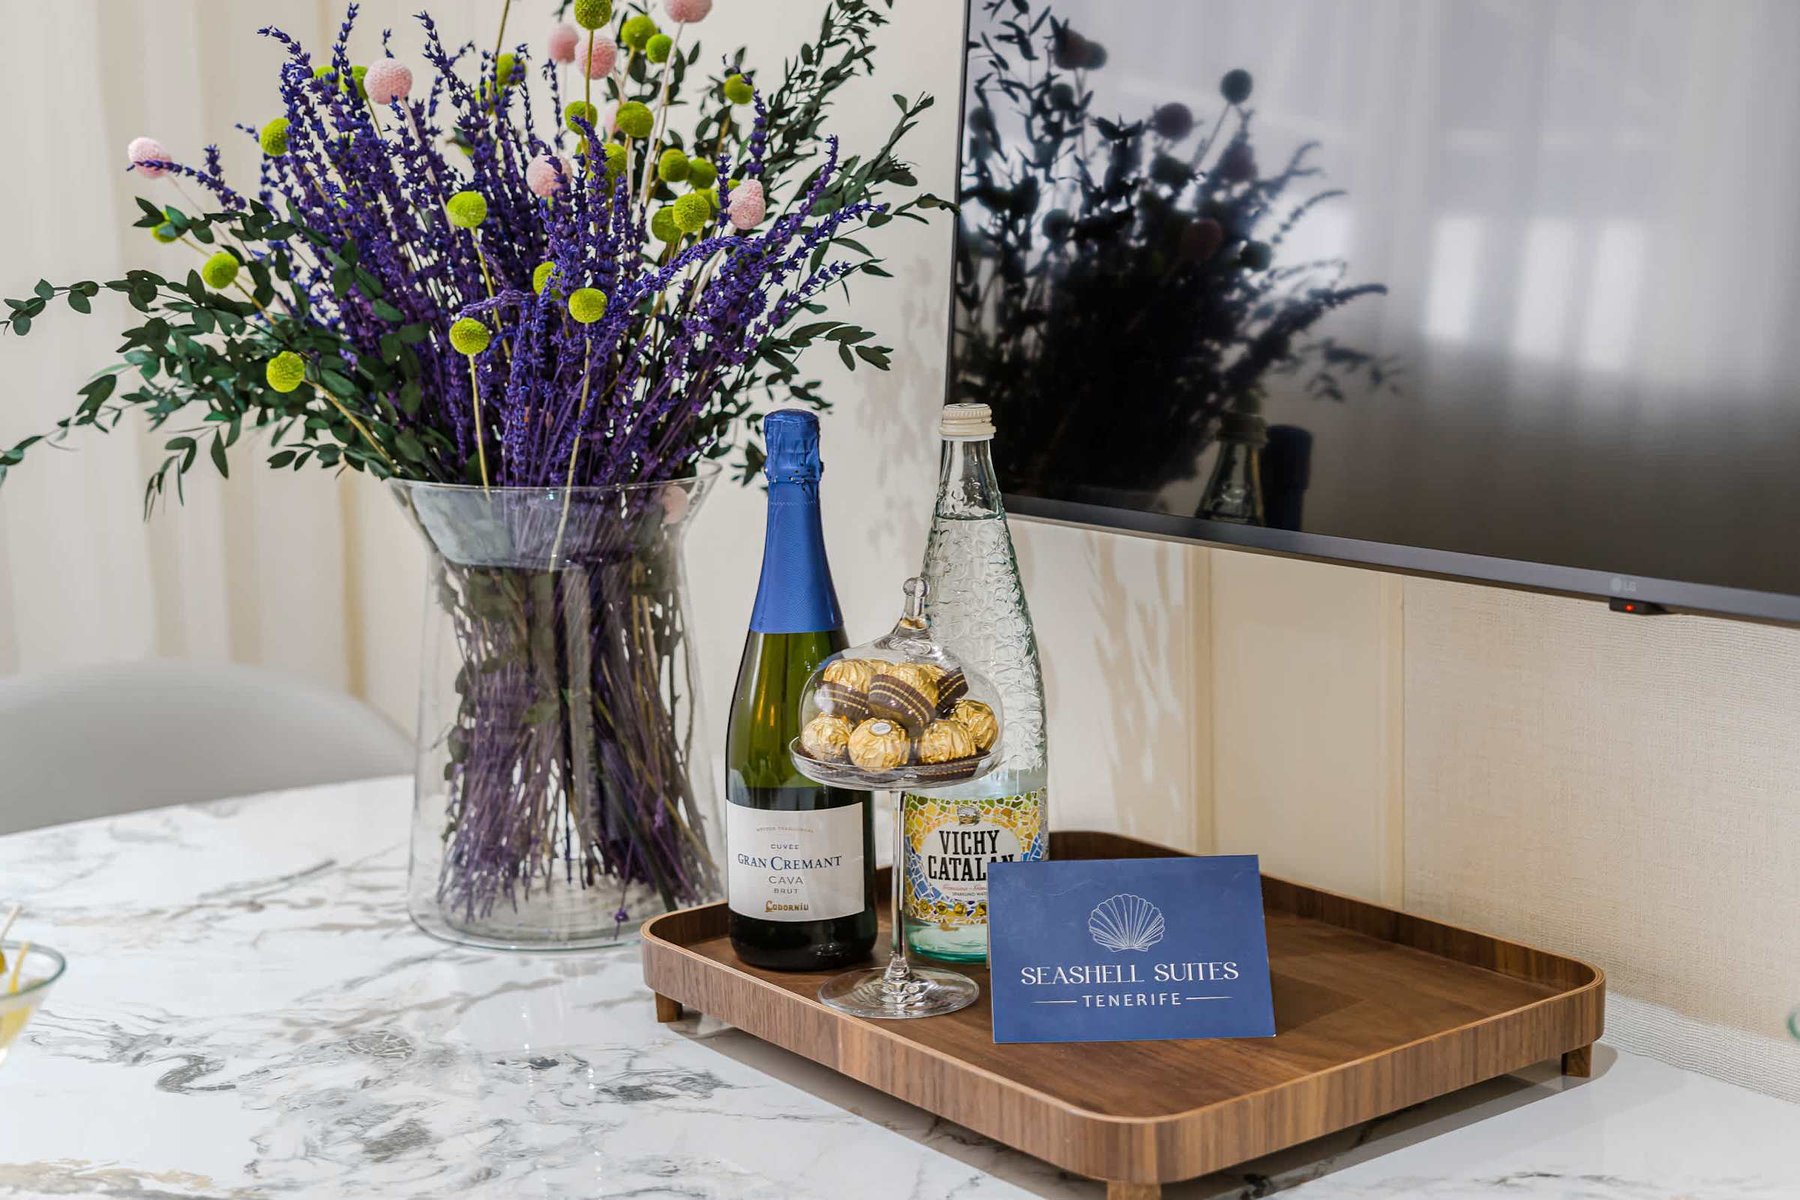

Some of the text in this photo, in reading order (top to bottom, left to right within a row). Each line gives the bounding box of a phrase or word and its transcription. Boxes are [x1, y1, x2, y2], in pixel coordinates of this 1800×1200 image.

[939, 830, 1000, 855] VICHY
[737, 853, 842, 871] GRAN CREMANT
[928, 854, 1015, 882] CATAL
[768, 875, 804, 885] CAVA
[1021, 961, 1239, 985] SEASHELL SUITES
[1082, 992, 1182, 1008] TENERIFE
